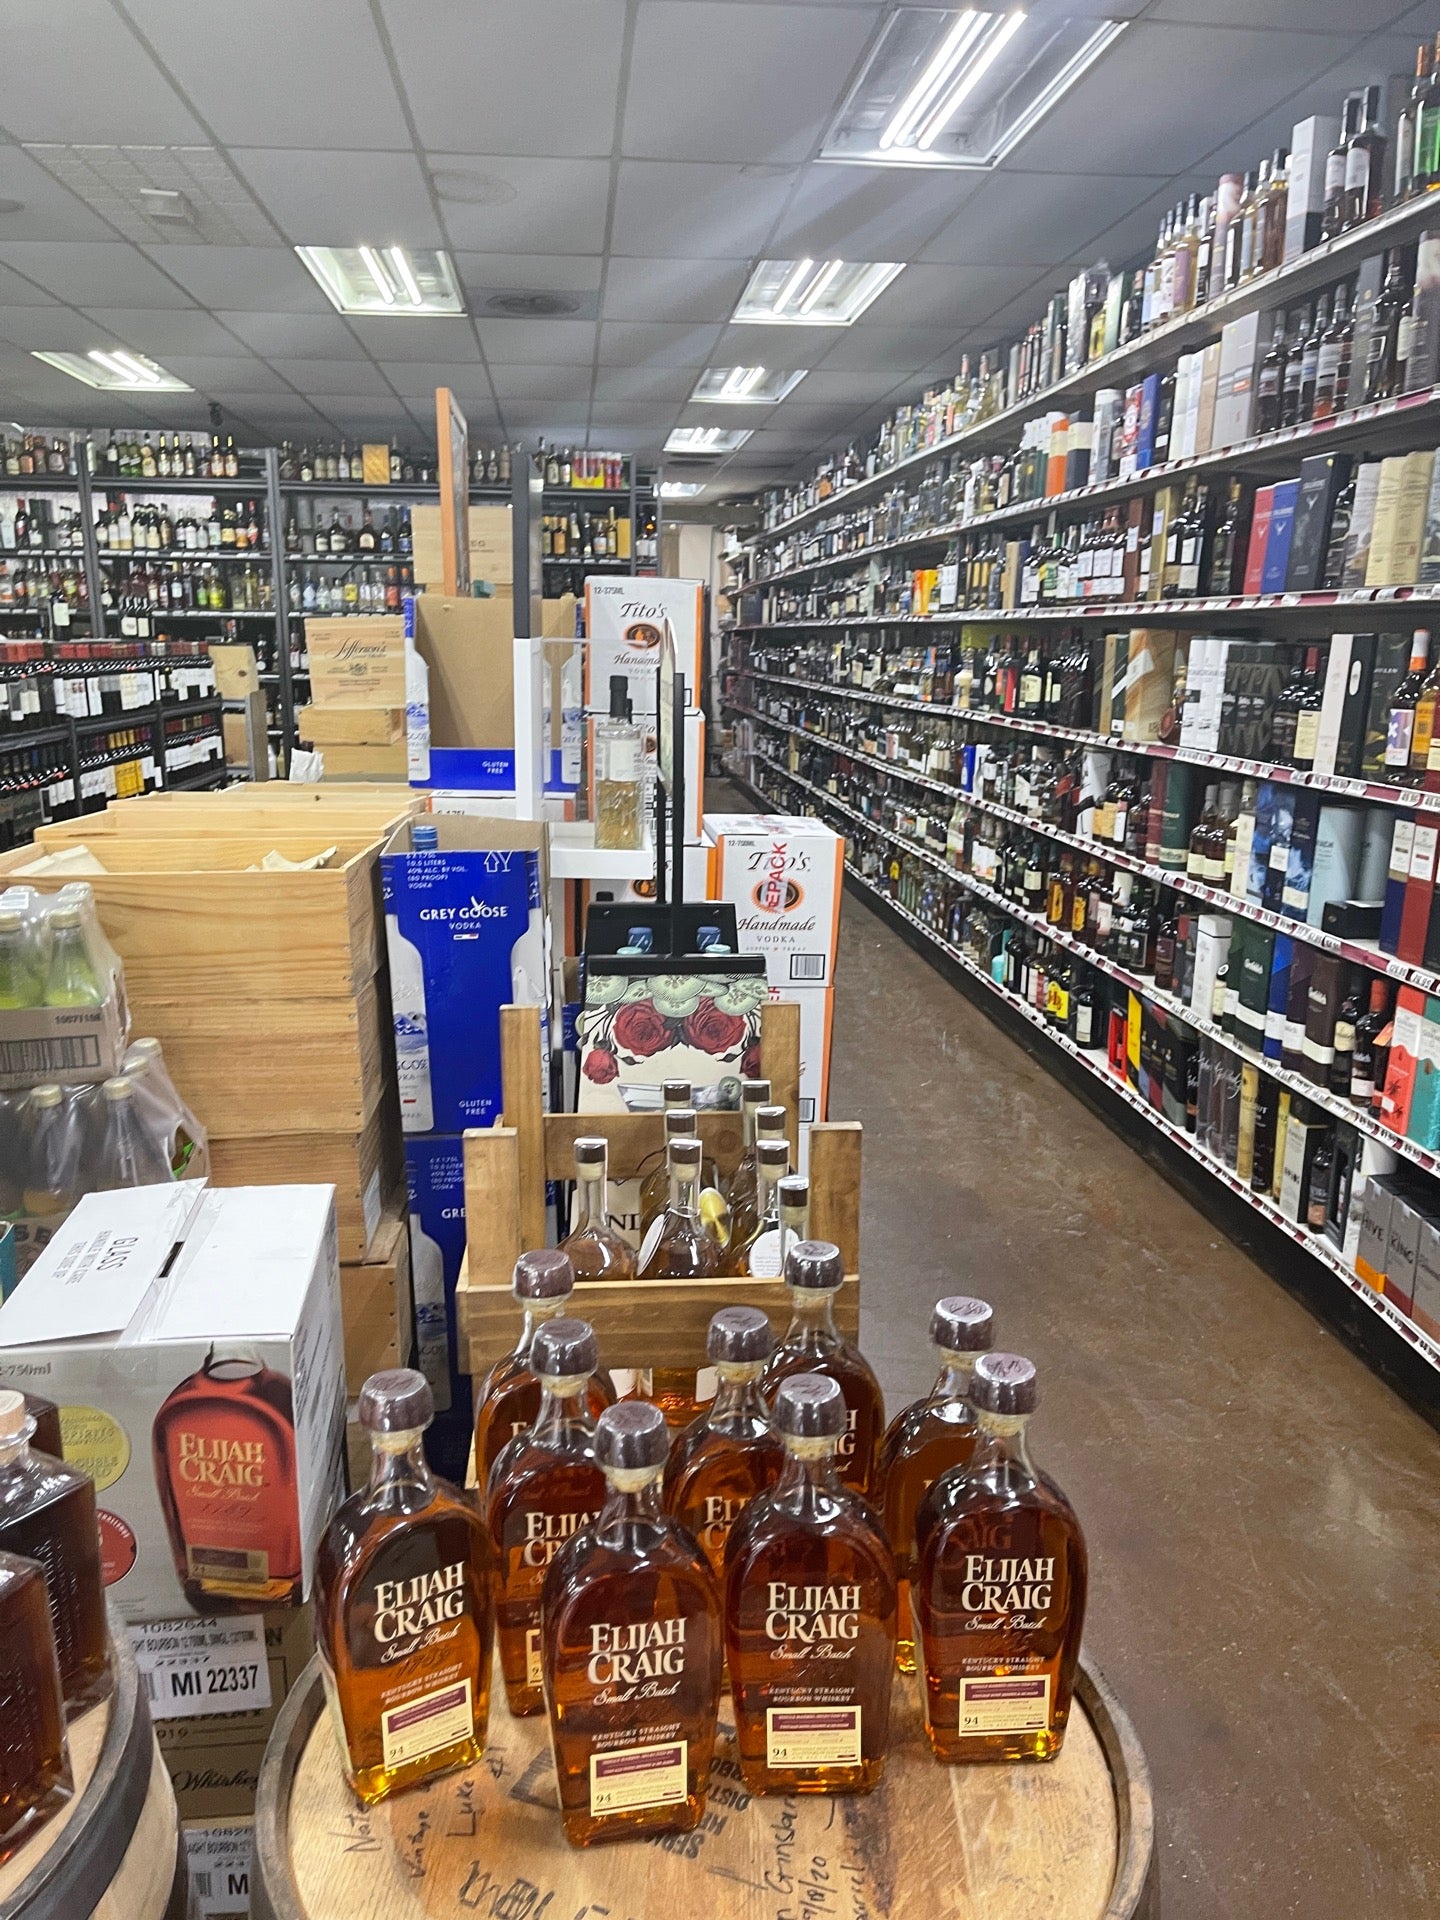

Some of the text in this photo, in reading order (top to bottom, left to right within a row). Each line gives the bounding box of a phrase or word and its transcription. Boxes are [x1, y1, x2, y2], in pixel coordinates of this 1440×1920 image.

[620, 602, 667, 618] Tito's
[419, 906, 509, 921] GREY GOOSE
[449, 922, 482, 930] VODKA
[737, 915, 816, 931] Handmade
[459, 1100, 492, 1108] GLUTEN
[465, 1107, 486, 1115] FREE
[96, 1237, 139, 1271] GLASS
[178, 1432, 265, 1464] ELIJAH
[178, 1456, 264, 1488] CRAIG
[963, 1555, 1057, 1587] ELIJAH
[374, 1560, 465, 1616] ELIJAH
[766, 1582, 862, 1617] ELIJAH
[961, 1582, 1052, 1614] CRAIG
[374, 1590, 464, 1643] CRAIG
[964, 1615, 1048, 1631] Small Batch
[765, 1610, 859, 1643] CRAIG
[380, 1622, 462, 1664] Small Batch
[588, 1617, 688, 1655] ELIJAH
[770, 1644, 856, 1661] Small Batch
[587, 1646, 686, 1685] CRAIG
[171, 1665, 258, 1698] MI 22337
[593, 1681, 681, 1706] Small Batch
[769, 1686, 855, 1695] KENTUCKY STRAIGHT
[814, 1694, 851, 1702] WHISKEY
[964, 1716, 979, 1726] 94
[592, 1728, 637, 1742] KENTUCKY
[389, 1745, 404, 1760] 94
[772, 1748, 788, 1757] 94
[596, 1793, 612, 1804] 94
